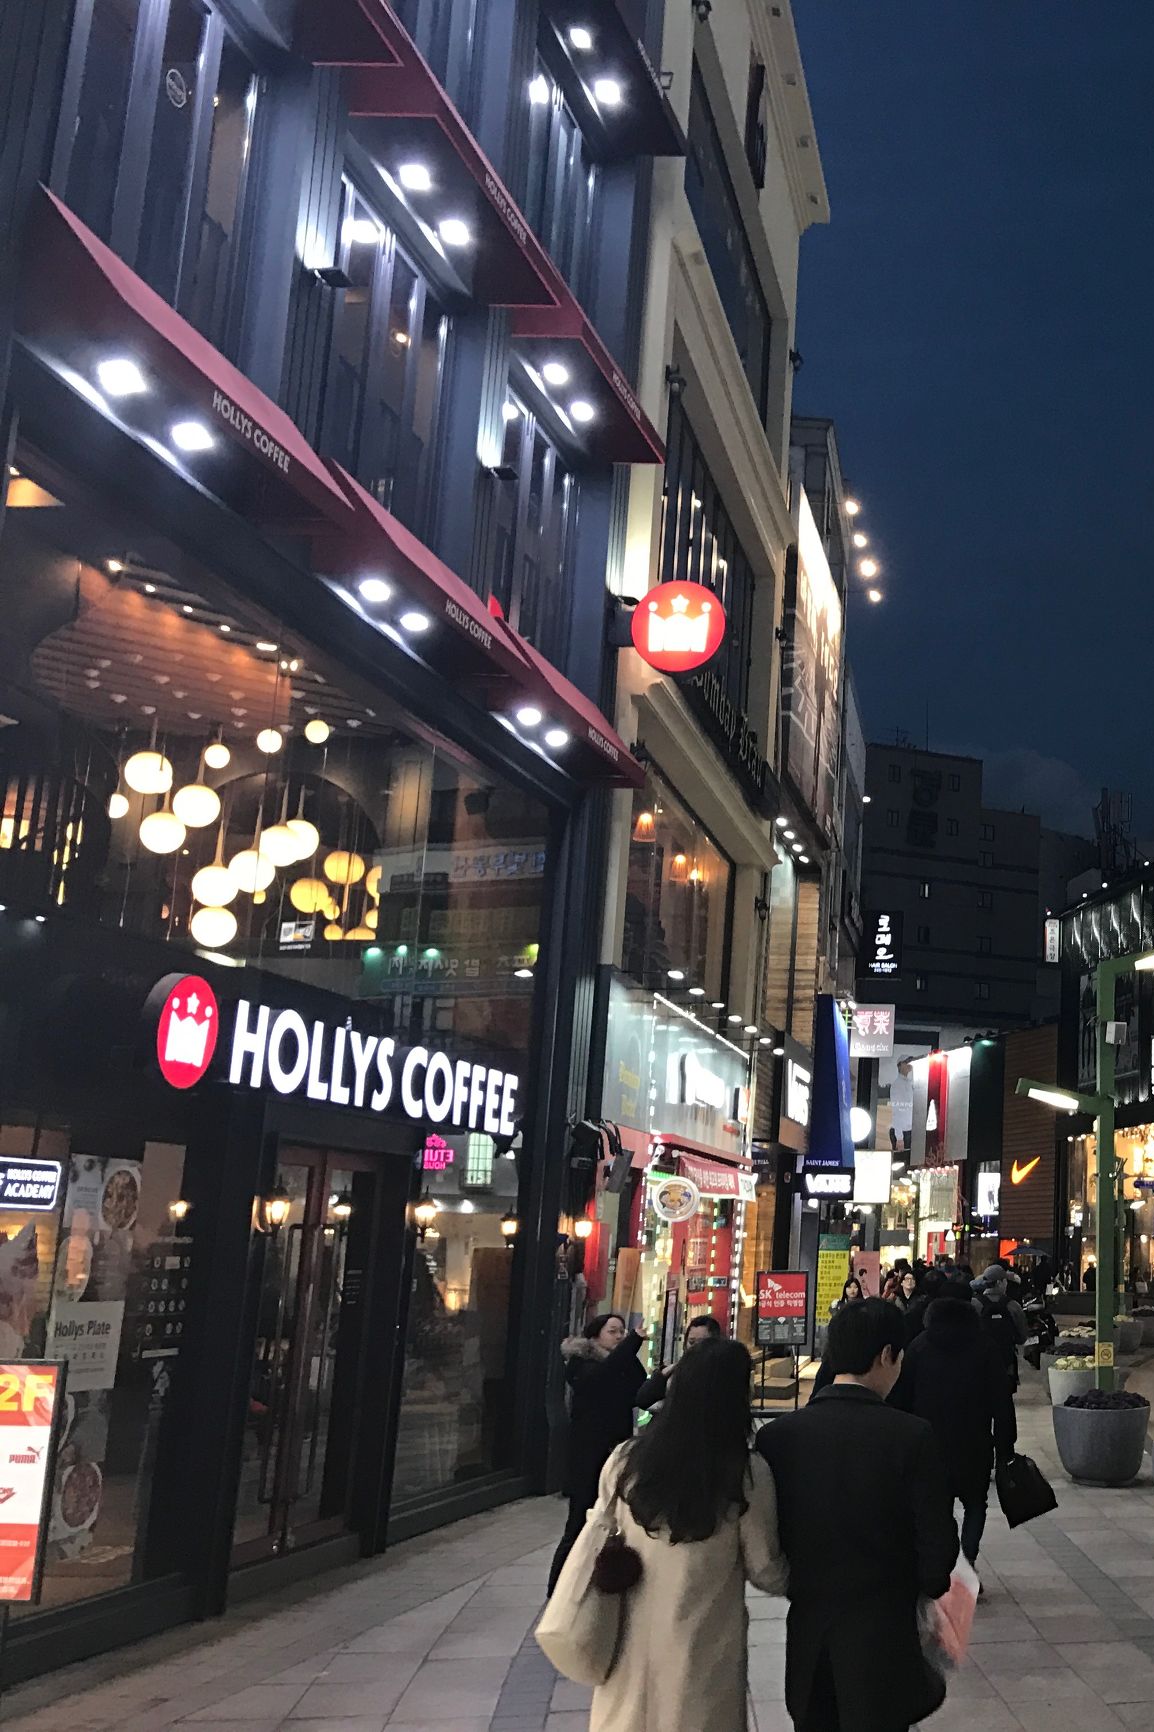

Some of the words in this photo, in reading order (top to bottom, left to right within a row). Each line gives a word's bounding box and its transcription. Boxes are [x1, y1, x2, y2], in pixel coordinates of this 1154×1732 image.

[212, 390, 252, 439] HOLLYS
[253, 428, 291, 473] COFFEE
[445, 599, 470, 629] HOLLYS
[469, 621, 492, 650] COFFEE
[588, 727, 604, 750] HOLLYS
[603, 739, 619, 762] COFFEE
[229, 999, 395, 1111] HOLLYS
[401, 1046, 519, 1136] COFFEE
[4, 1182, 55, 1200] ACADEMY
[759, 1289, 772, 1299] SK
[775, 1289, 806, 1299] telecom
[54, 1320, 84, 1340] Hollys
[86, 1320, 111, 1336] Plate
[8, 1454, 36, 1464] PUMA
